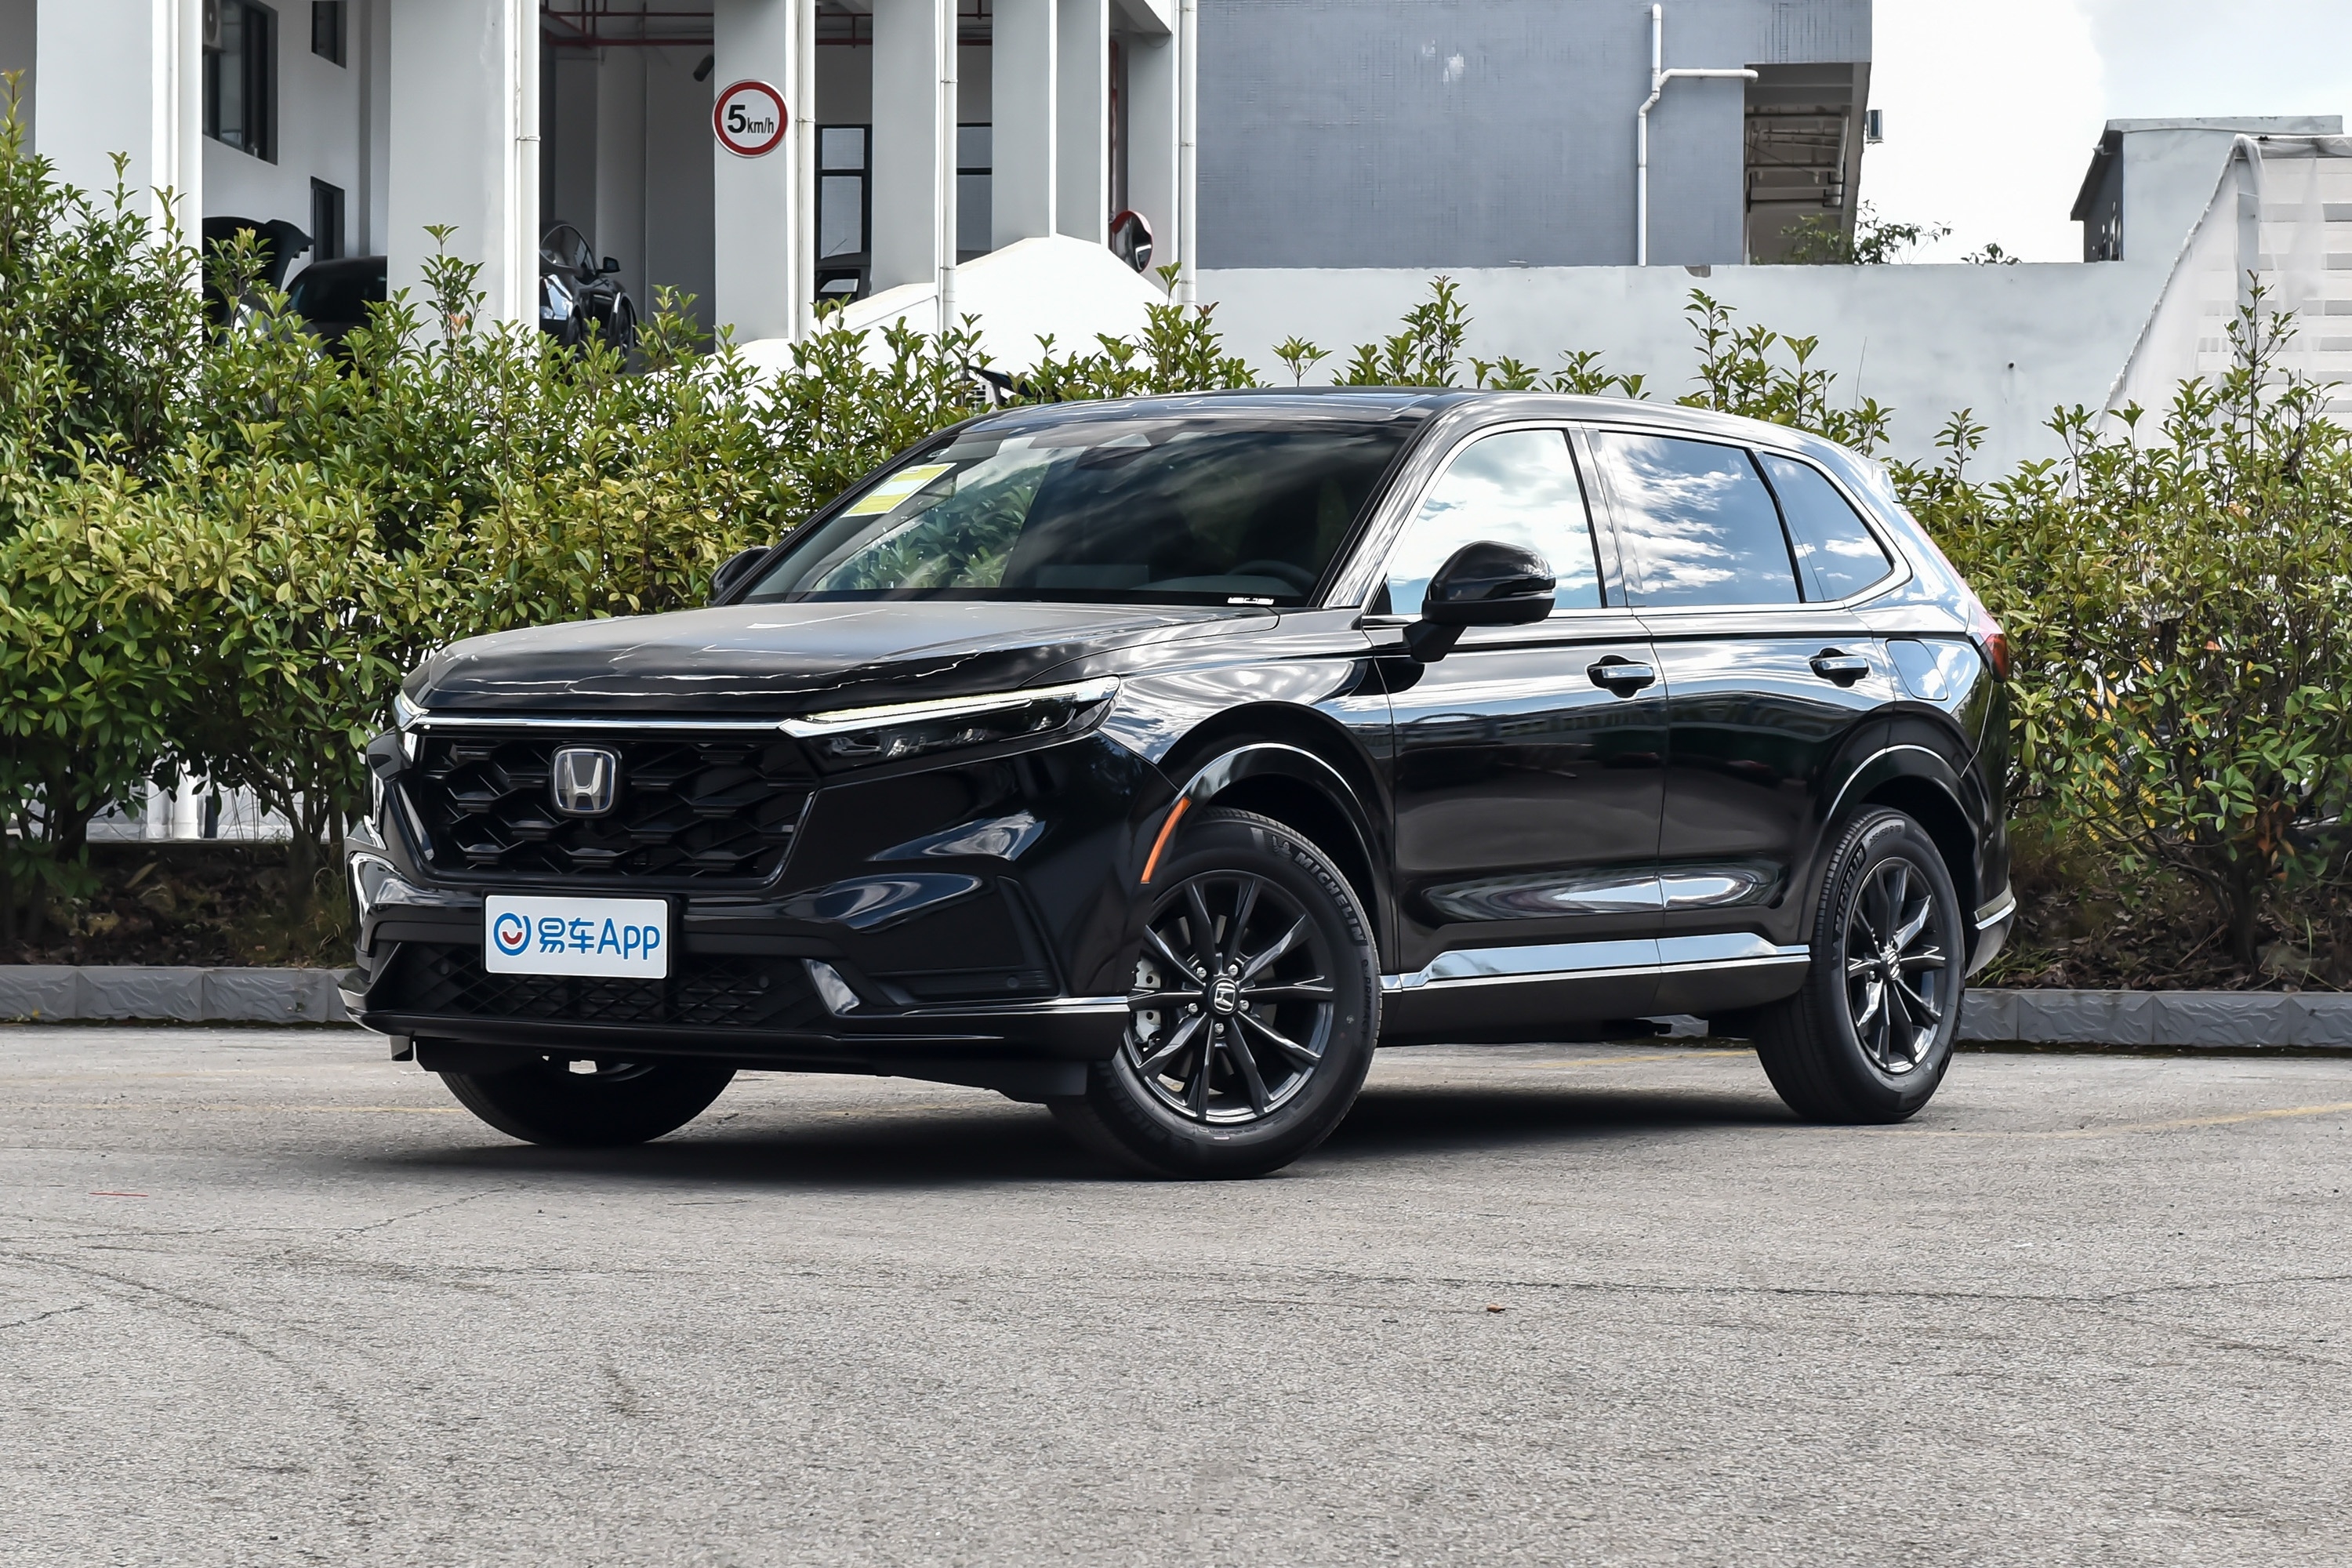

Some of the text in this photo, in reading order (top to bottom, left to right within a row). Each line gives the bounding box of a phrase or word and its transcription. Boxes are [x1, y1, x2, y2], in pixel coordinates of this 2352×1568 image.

[727, 104, 775, 134] 5km/h
[1294, 851, 1365, 941] MICHELIN
[538, 916, 660, 960] 易车App
